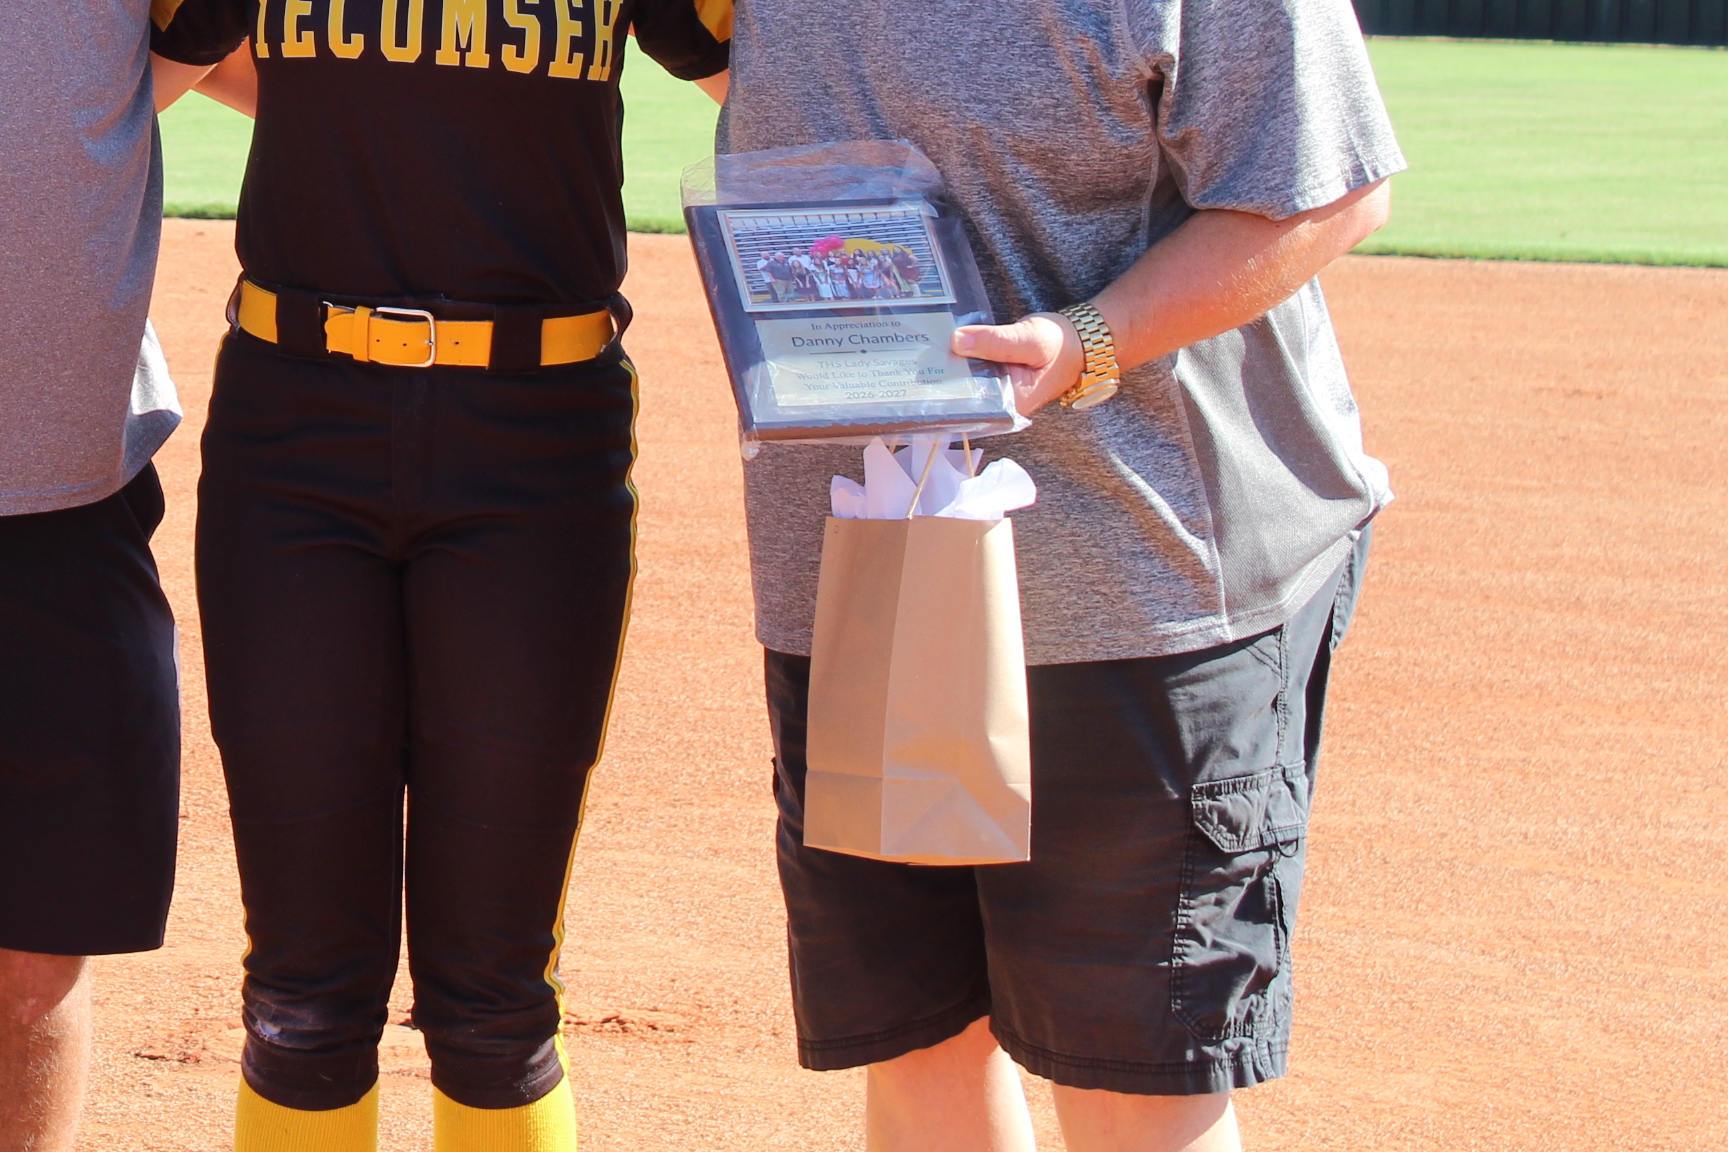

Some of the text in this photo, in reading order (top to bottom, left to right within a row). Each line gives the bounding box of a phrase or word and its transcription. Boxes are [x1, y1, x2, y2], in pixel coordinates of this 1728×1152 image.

[824, 320, 889, 332] Appreciation
[791, 333, 930, 348] Danny Chambers
[817, 357, 917, 369] THS Lady Savages
[796, 371, 829, 381] Would
[831, 370, 855, 380] Like
[869, 369, 902, 378] Thank
[904, 367, 925, 377] You
[927, 367, 945, 375] For
[804, 378, 942, 392] Your Valuable Contribution
[845, 389, 907, 400] 2026-2027
